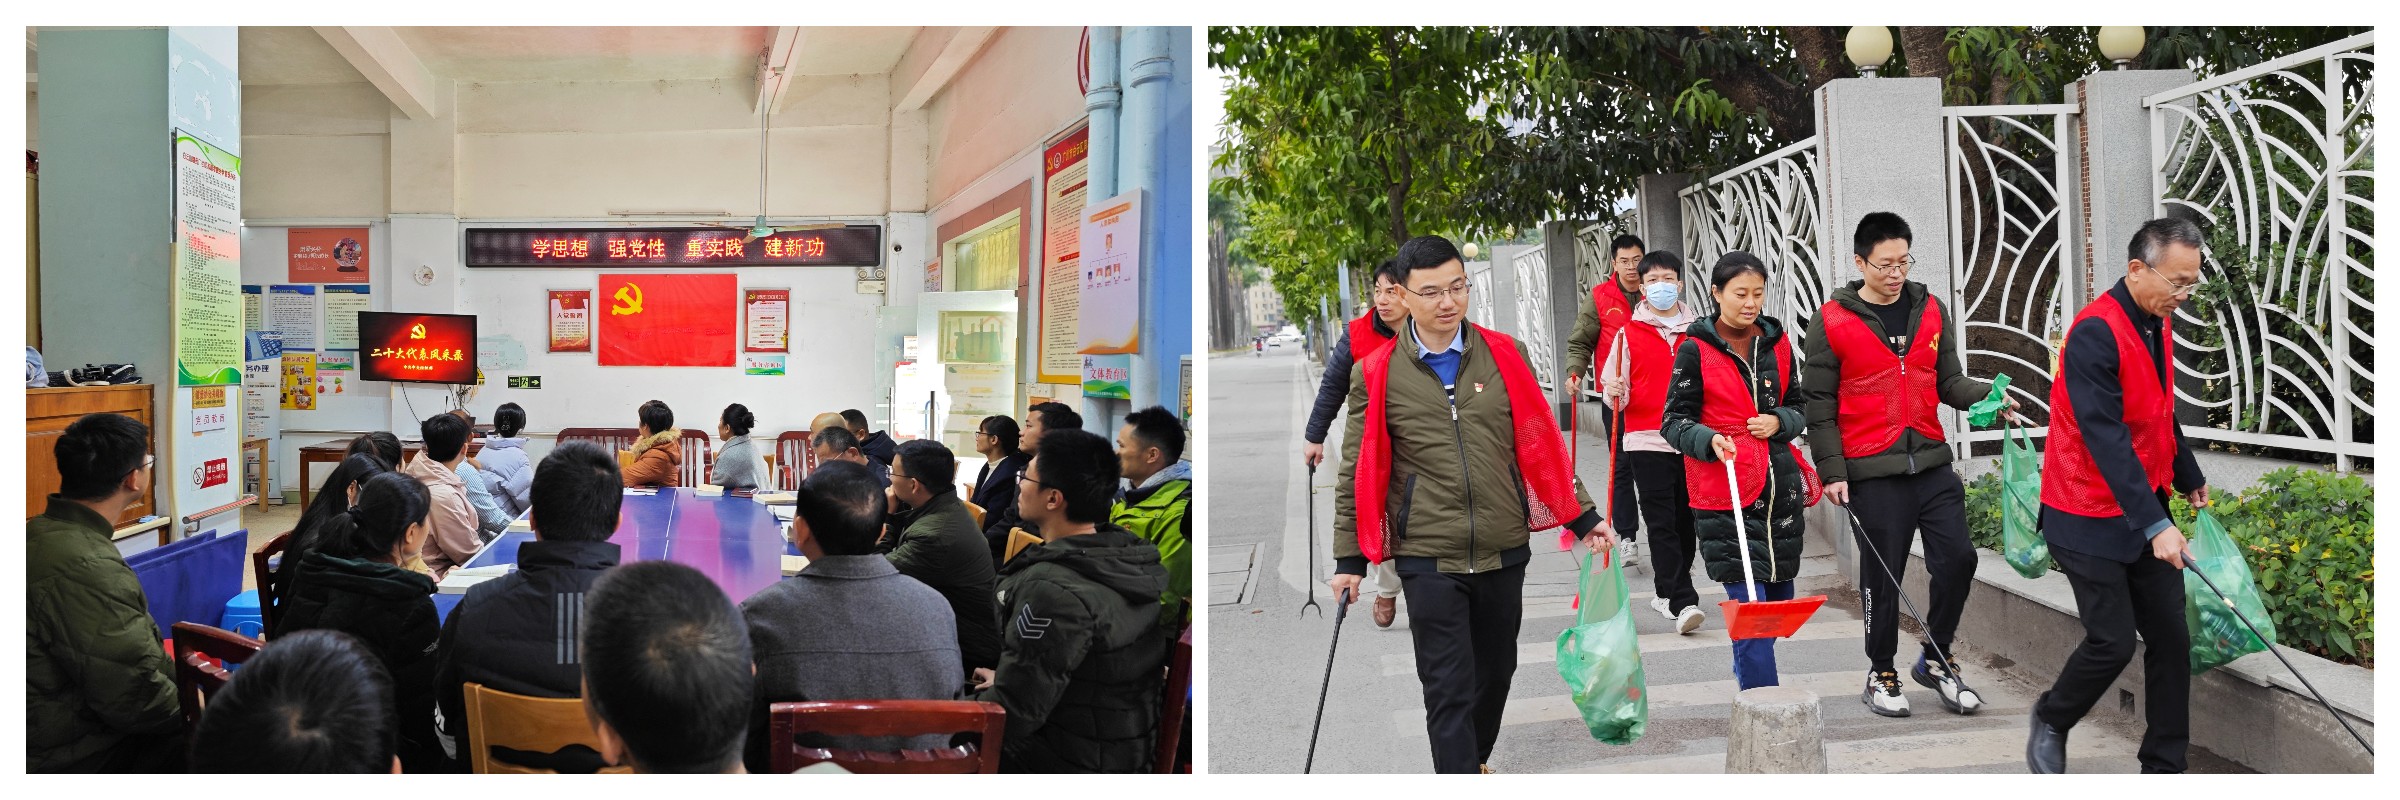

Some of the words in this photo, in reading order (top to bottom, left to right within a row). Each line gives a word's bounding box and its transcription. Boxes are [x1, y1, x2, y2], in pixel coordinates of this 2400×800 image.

[533, 238, 588, 258] 学思想
[608, 238, 666, 258] 强党性
[686, 238, 744, 258] 重实践
[764, 237, 825, 258] 建新功
[370, 347, 464, 362] 二十大代表风采录
